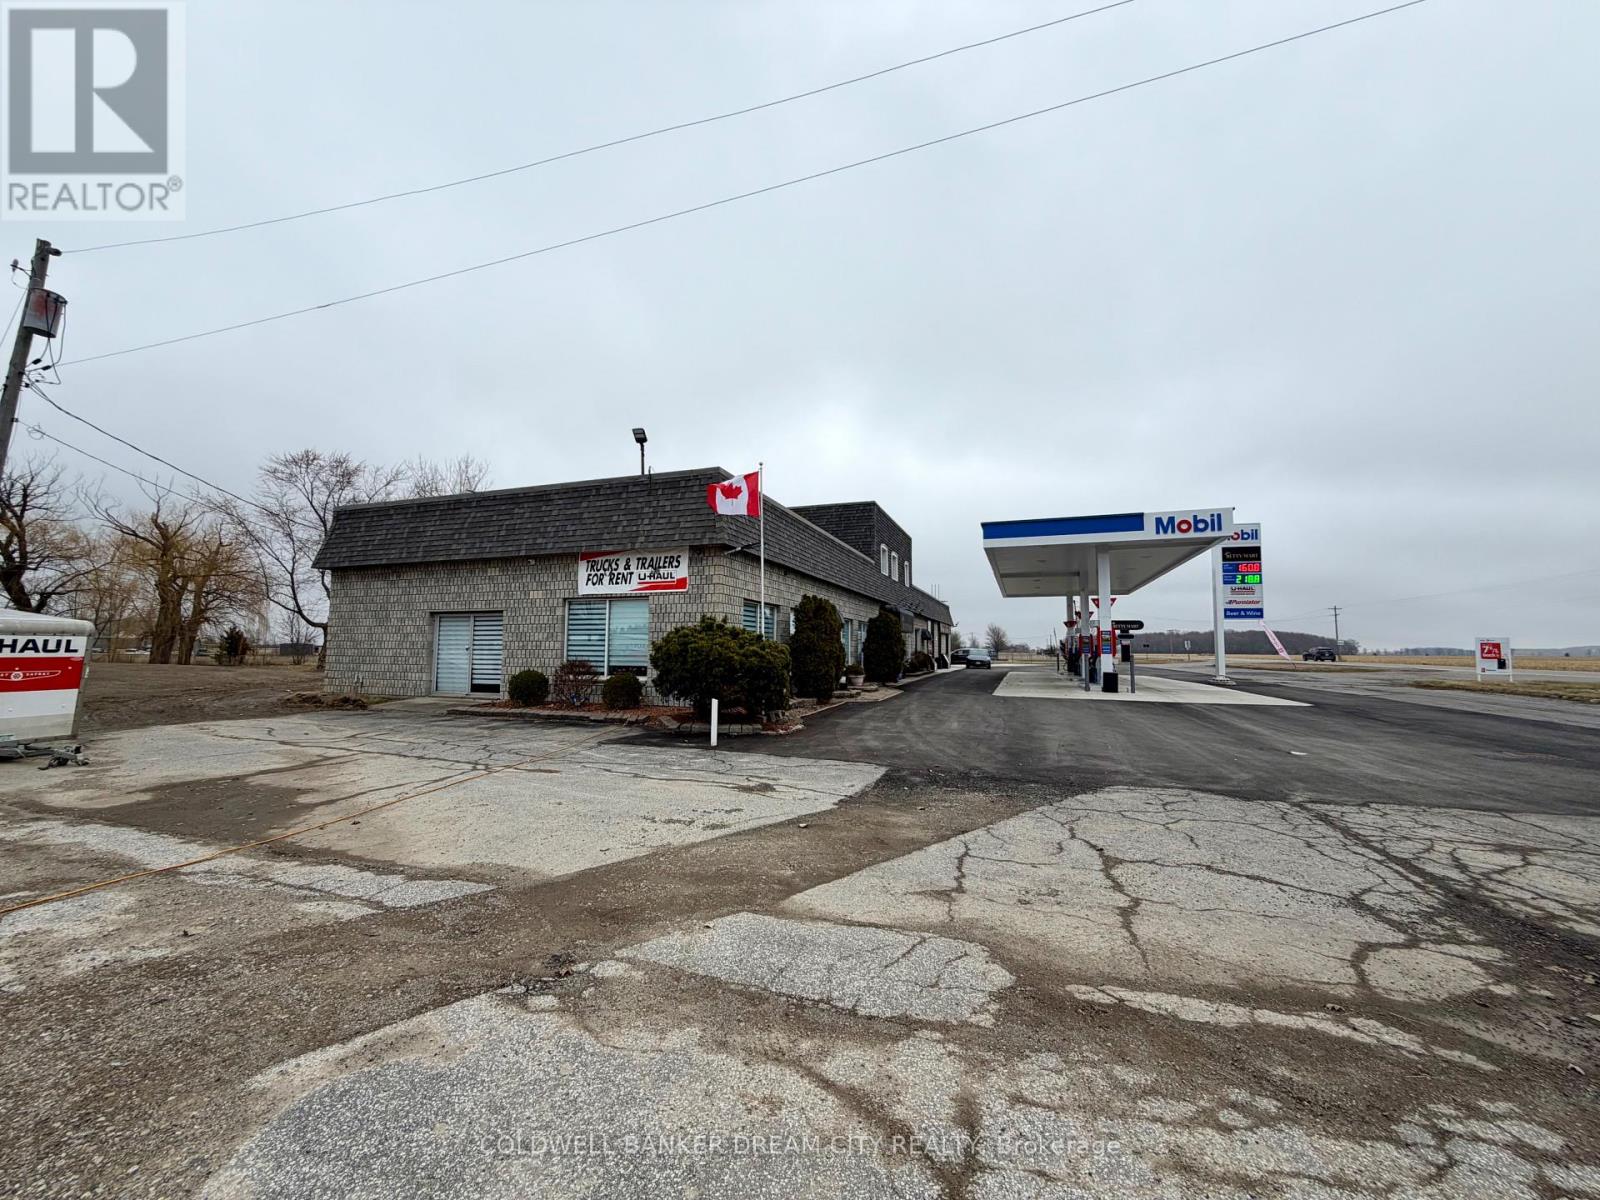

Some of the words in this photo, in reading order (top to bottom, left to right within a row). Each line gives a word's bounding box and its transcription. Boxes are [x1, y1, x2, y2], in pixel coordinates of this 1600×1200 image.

[1155, 513, 1222, 535] Mobil
[1227, 529, 1258, 541] obil
[586, 559, 619, 573] TRUCKS
[624, 557, 631, 571] &
[636, 555, 681, 570] TRAILERS
[586, 573, 604, 586] FOR
[608, 572, 634, 585] RENT
[638, 572, 675, 580] U-HAUL
